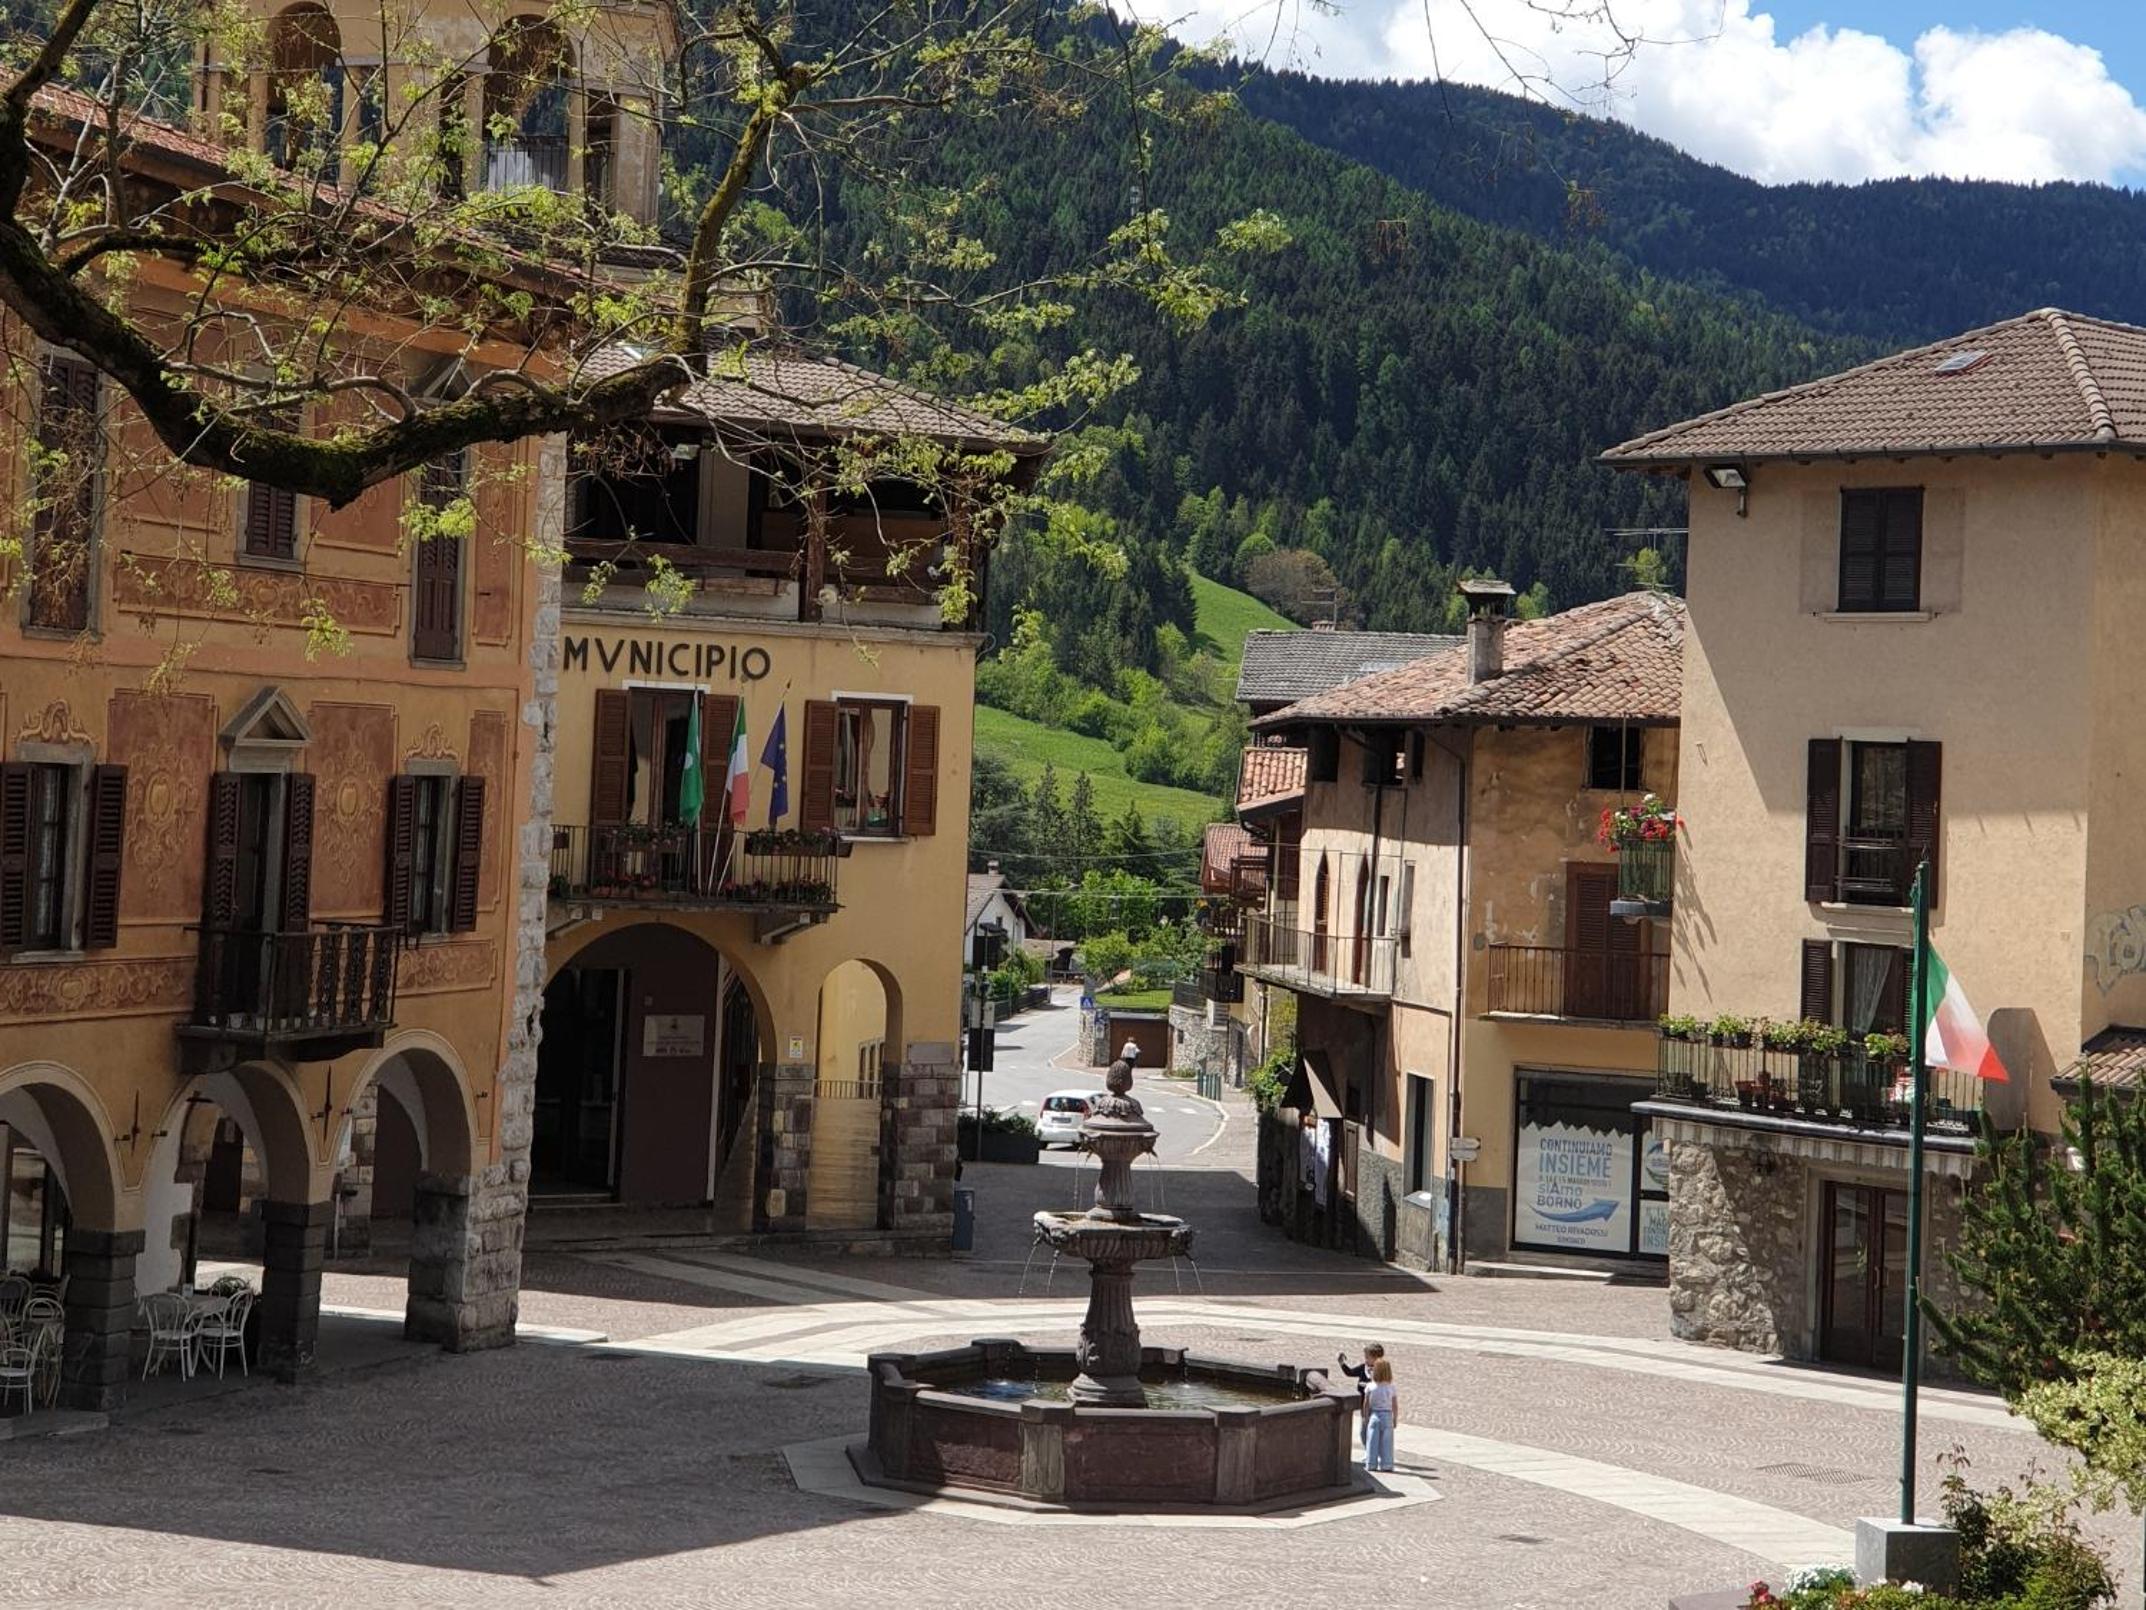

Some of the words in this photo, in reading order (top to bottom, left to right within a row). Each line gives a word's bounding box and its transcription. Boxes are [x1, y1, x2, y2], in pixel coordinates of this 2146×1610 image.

[563, 636, 771, 680] MVNICIPIO
[1538, 1152, 1613, 1178] INSIEME
[1537, 1195, 1583, 1210] BORNO
